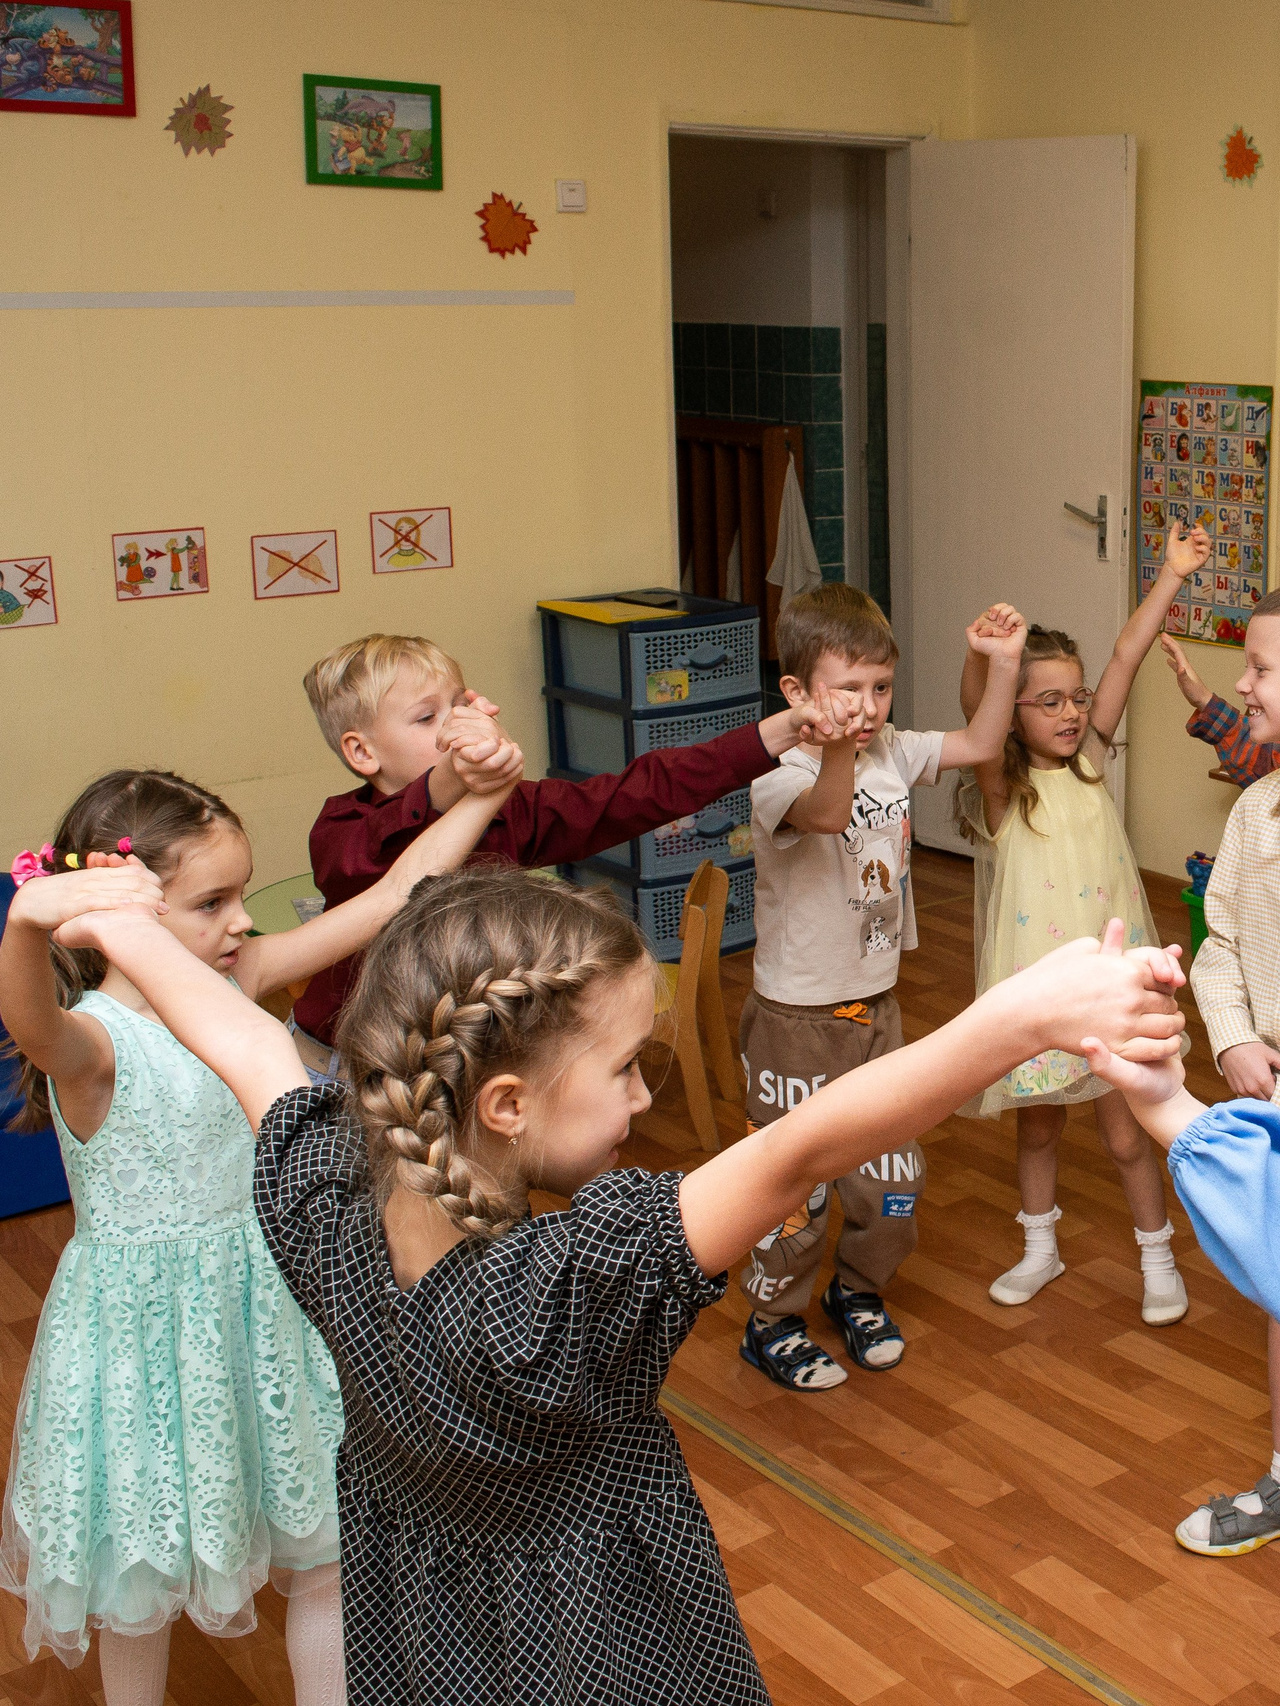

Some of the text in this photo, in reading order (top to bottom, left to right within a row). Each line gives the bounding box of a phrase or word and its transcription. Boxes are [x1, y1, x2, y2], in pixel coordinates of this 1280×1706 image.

[1185, 385, 1227, 397] Алфавит
[1146, 401, 1255, 421] А Б В Г Д
[1144, 431, 1255, 454] Е Ё Ж З И
[1144, 463, 1254, 489] Й К Л М Н
[1143, 501, 1252, 524] О П Р С Т
[1144, 534, 1251, 559] У Ц Ч
[1193, 573, 1202, 586] Ъ
[1216, 575, 1228, 590] Ы
[1243, 579, 1251, 593] Ь
[1168, 604, 1202, 621] Ю Я
